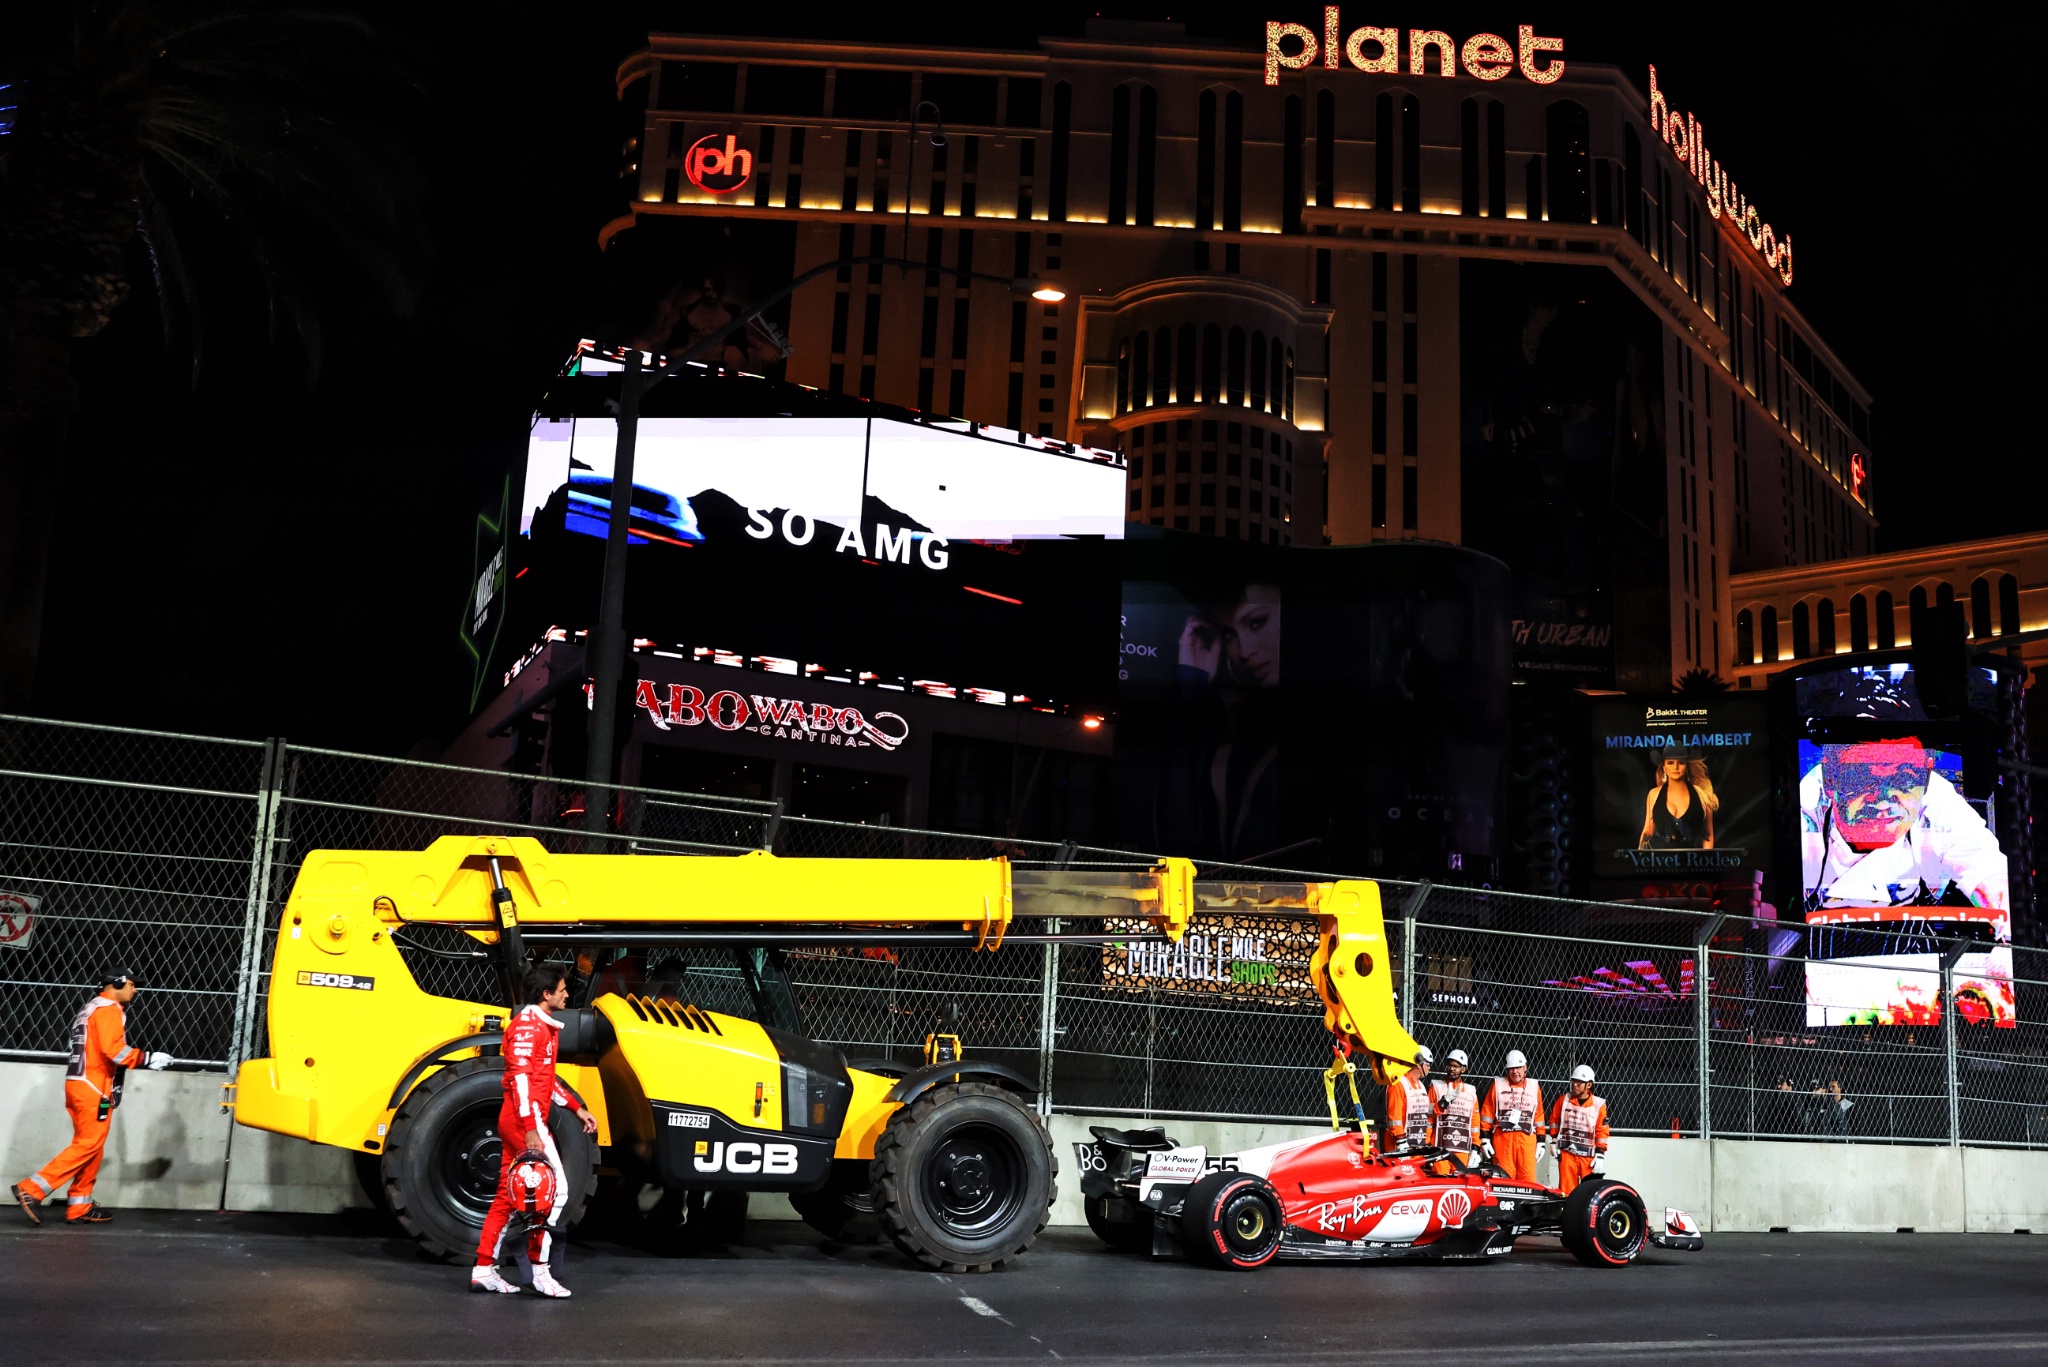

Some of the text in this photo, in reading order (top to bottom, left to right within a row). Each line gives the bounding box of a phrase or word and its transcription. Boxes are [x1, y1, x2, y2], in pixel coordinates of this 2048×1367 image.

[1265, 6, 1565, 85] planet
[694, 135, 752, 181] ph
[1649, 64, 1792, 286] hollywood
[744, 505, 949, 571] SO AMG
[1537, 623, 1611, 648] URBAN
[636, 679, 866, 735] ABO WABO
[759, 725, 857, 747] CANTINA
[1605, 732, 1752, 749] MIRANDA LAMBERT
[1624, 849, 1741, 867] Velvet Rodeo
[1127, 931, 1265, 982] MIRACLE MILE
[310, 972, 372, 990] 509-42
[1231, 961, 1277, 985] SHOPS
[1432, 993, 1477, 1005] SEPHORA
[669, 1114, 708, 1128] 11772754
[693, 1141, 798, 1175] JCB
